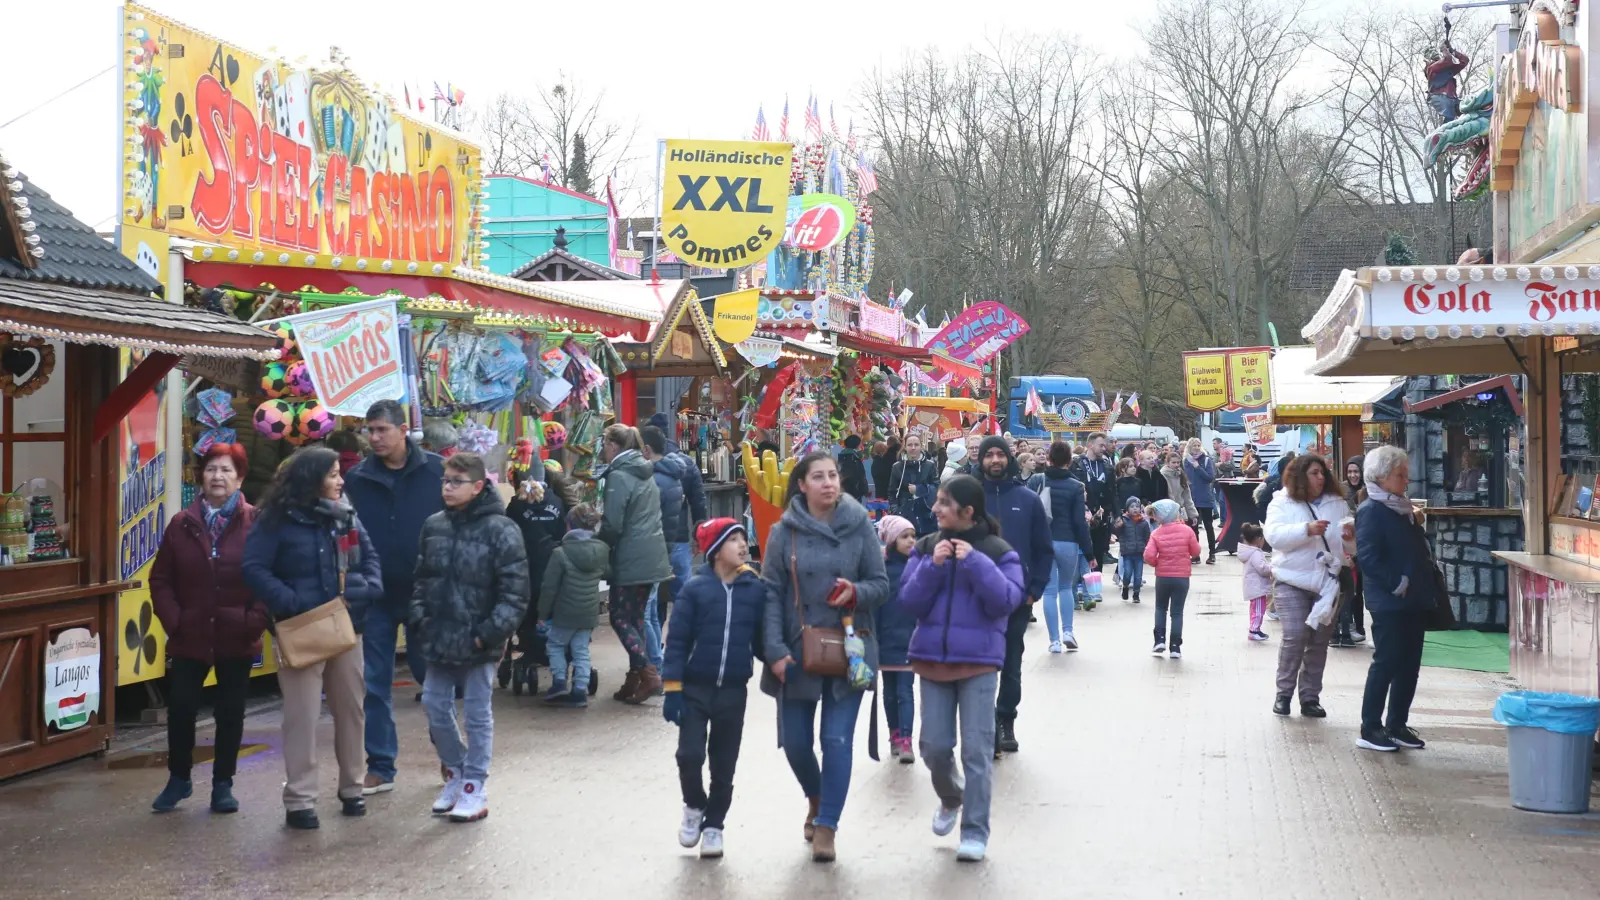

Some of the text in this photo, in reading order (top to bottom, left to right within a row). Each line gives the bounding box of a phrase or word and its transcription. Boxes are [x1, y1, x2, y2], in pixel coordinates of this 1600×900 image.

[670, 149, 784, 165] Holländische
[672, 175, 774, 213] XXL
[668, 223, 773, 264] Pommes
[795, 224, 822, 245] it!
[1403, 282, 1492, 315] Cola
[717, 311, 753, 321] Frikandel
[1191, 366, 1221, 375] Glühwein
[1241, 357, 1259, 366] Bier
[1196, 377, 1217, 385] Kakao
[1241, 377, 1263, 386] Fass
[1192, 387, 1223, 396] Lumumba
[120, 450, 166, 527] MONTE
[121, 501, 165, 580] CARLO
[54, 665, 90, 692] Langos
